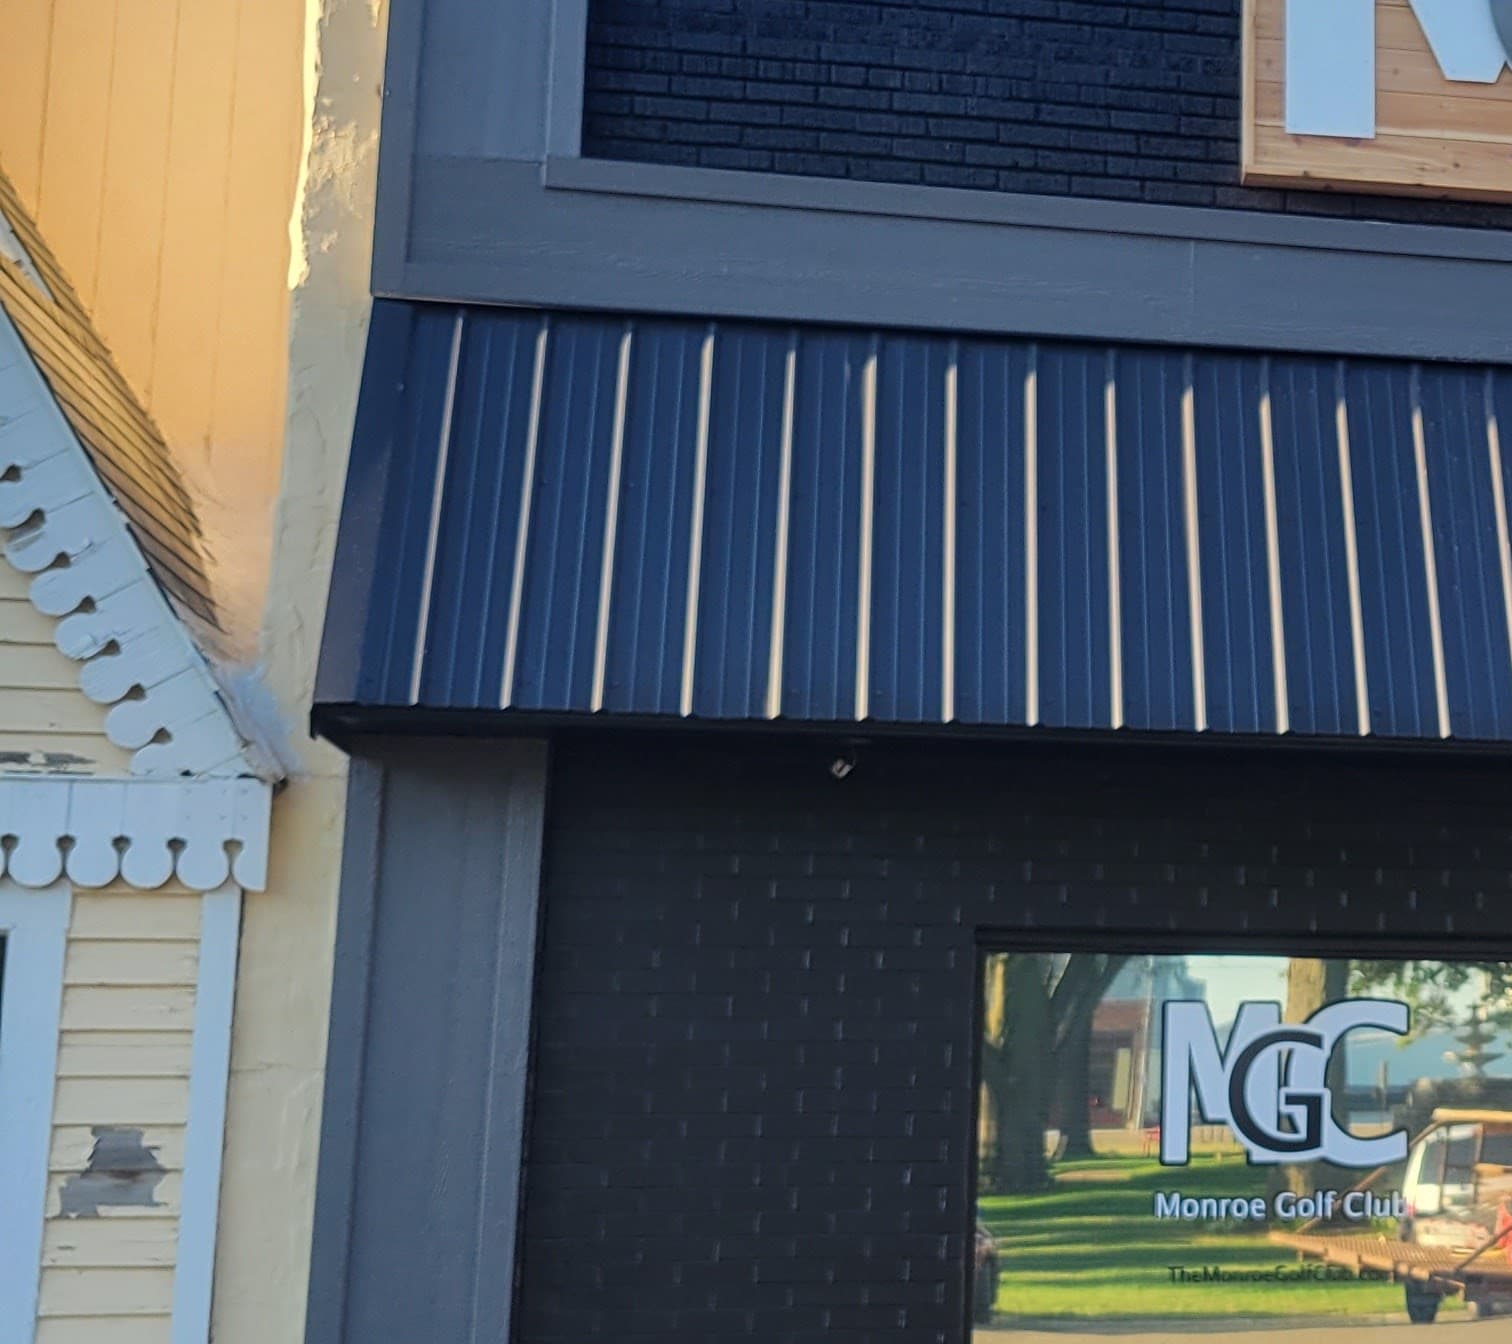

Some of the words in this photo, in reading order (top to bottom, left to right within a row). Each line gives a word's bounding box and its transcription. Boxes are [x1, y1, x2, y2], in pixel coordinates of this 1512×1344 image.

[1160, 997, 1410, 1167] MGC
[1154, 1191, 1266, 1220] Monroe
[1274, 1190, 1339, 1221] Golf
[1343, 1190, 1408, 1221] Club
